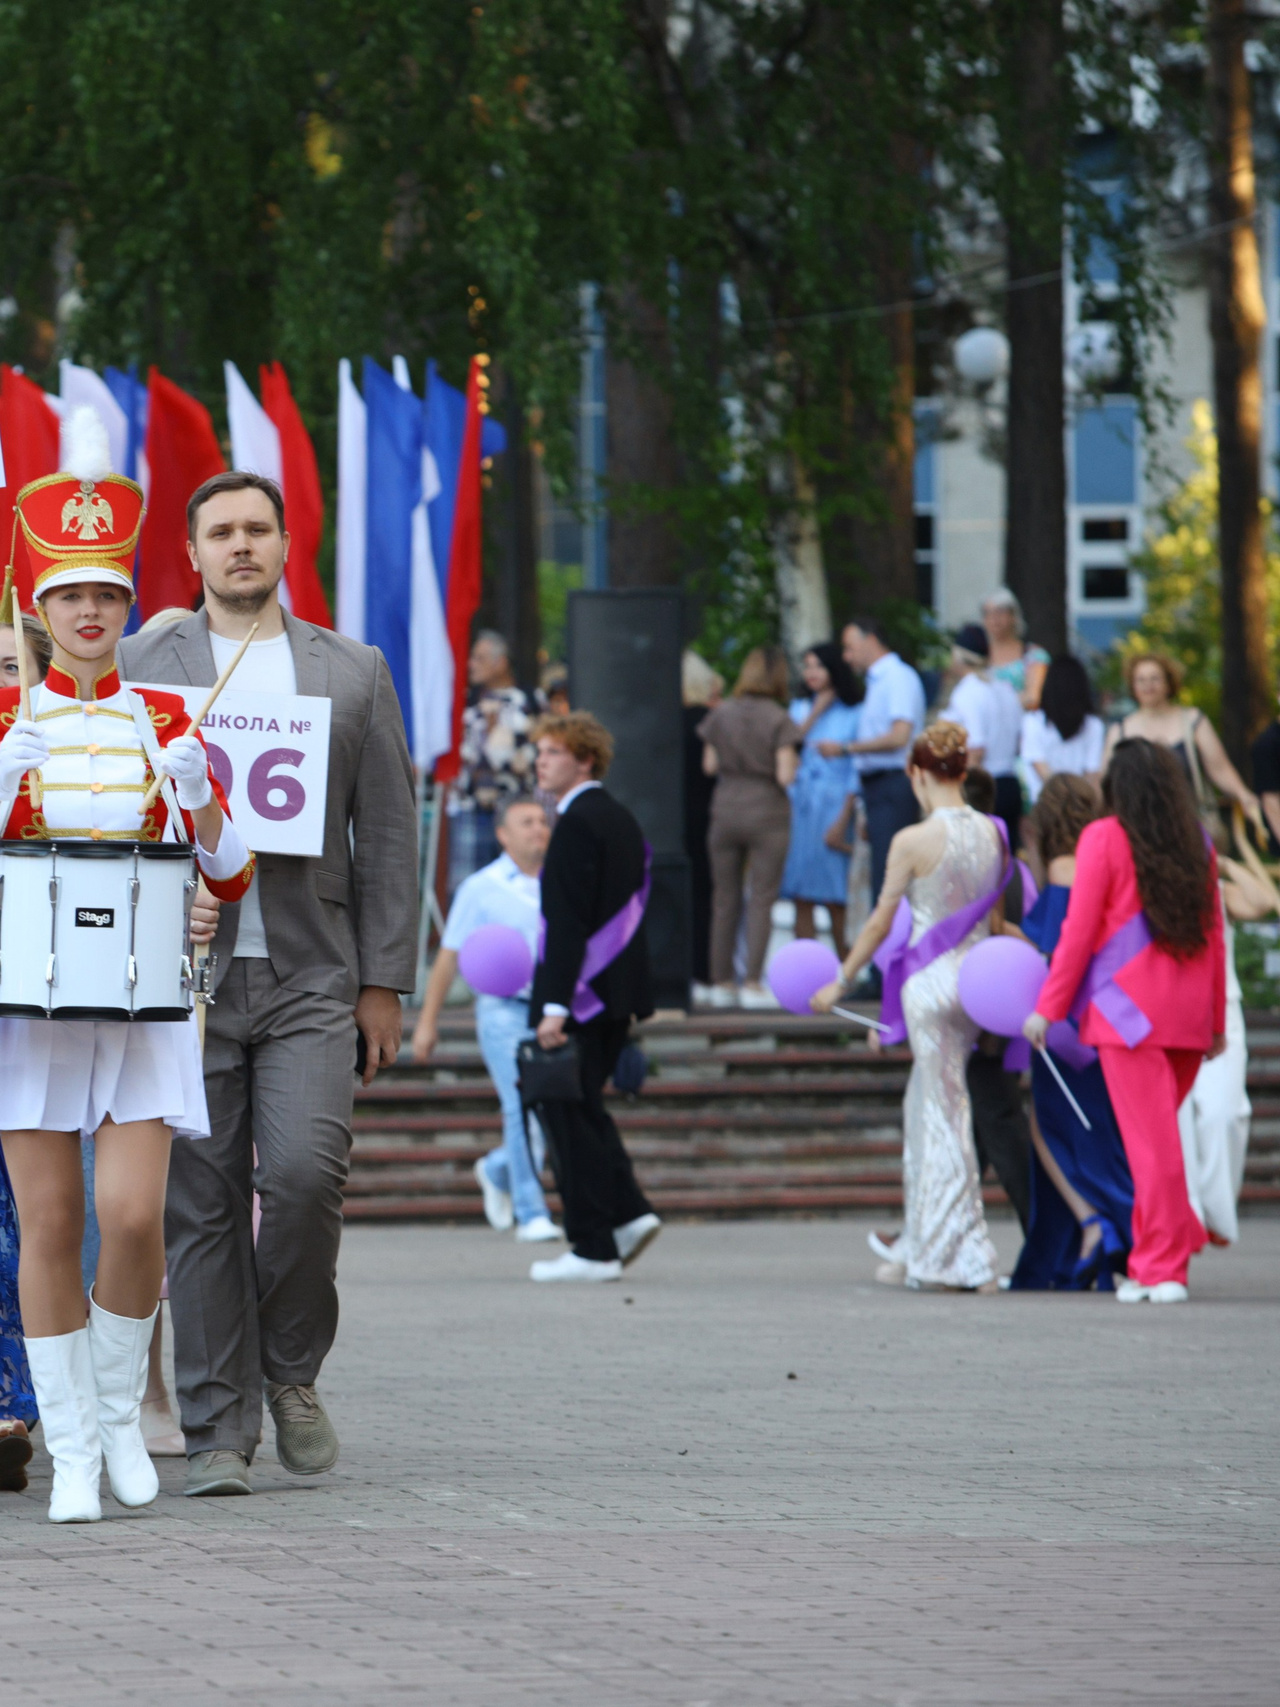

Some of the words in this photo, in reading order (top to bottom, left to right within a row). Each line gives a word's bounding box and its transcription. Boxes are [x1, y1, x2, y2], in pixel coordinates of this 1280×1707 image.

[199, 712, 280, 733] ШКОЛА
[290, 720, 312, 734] №
[78, 911, 111, 926] Stagg
